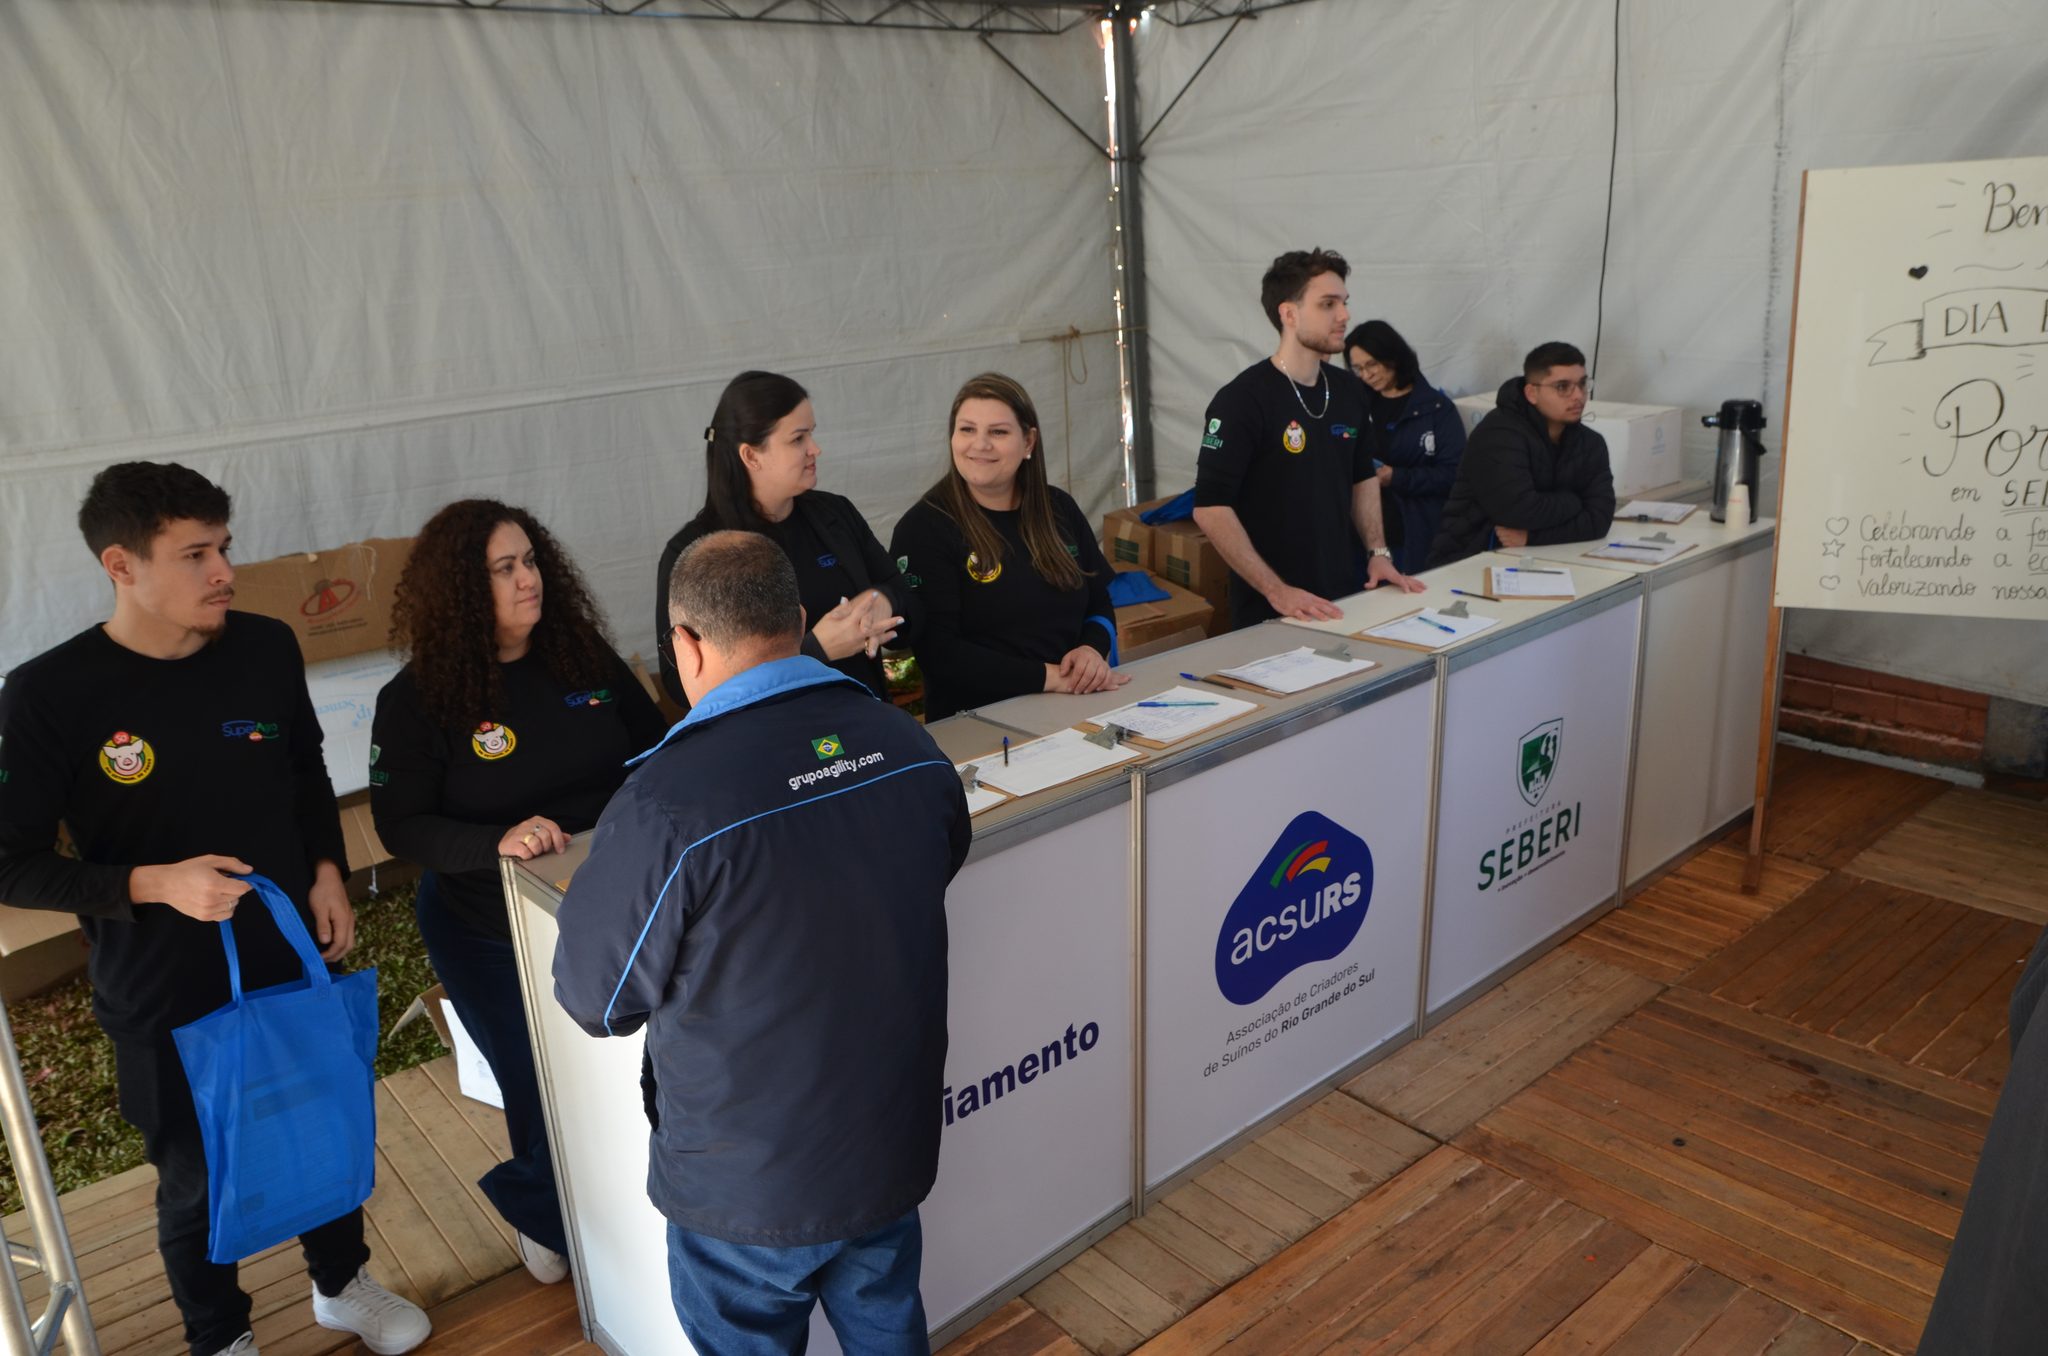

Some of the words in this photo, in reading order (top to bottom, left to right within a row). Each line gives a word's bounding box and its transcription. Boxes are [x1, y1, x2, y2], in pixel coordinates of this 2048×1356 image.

[1944, 300, 2008, 337] DIA
[1951, 486, 1981, 502] em
[2002, 479, 2048, 507] SE
[1860, 510, 1975, 542] Celebrando
[1996, 527, 2012, 541] a
[1993, 552, 2013, 568] a
[788, 752, 885, 791] grupoagility.com
[1477, 801, 1581, 891] SEBERI
[1203, 1061, 1219, 1077] de
[1222, 1037, 1262, 1067] Suínos
[1264, 1027, 1278, 1043] do
[1281, 1015, 1299, 1033] Rio
[1302, 991, 1341, 1020] Grande
[1343, 981, 1356, 997] do
[1359, 968, 1376, 987] Sul
[1226, 1002, 1291, 1045] Associação
[1293, 994, 1307, 1007] de
[1309, 962, 1359, 997] Criadores
[943, 1021, 1100, 1126] iamento
